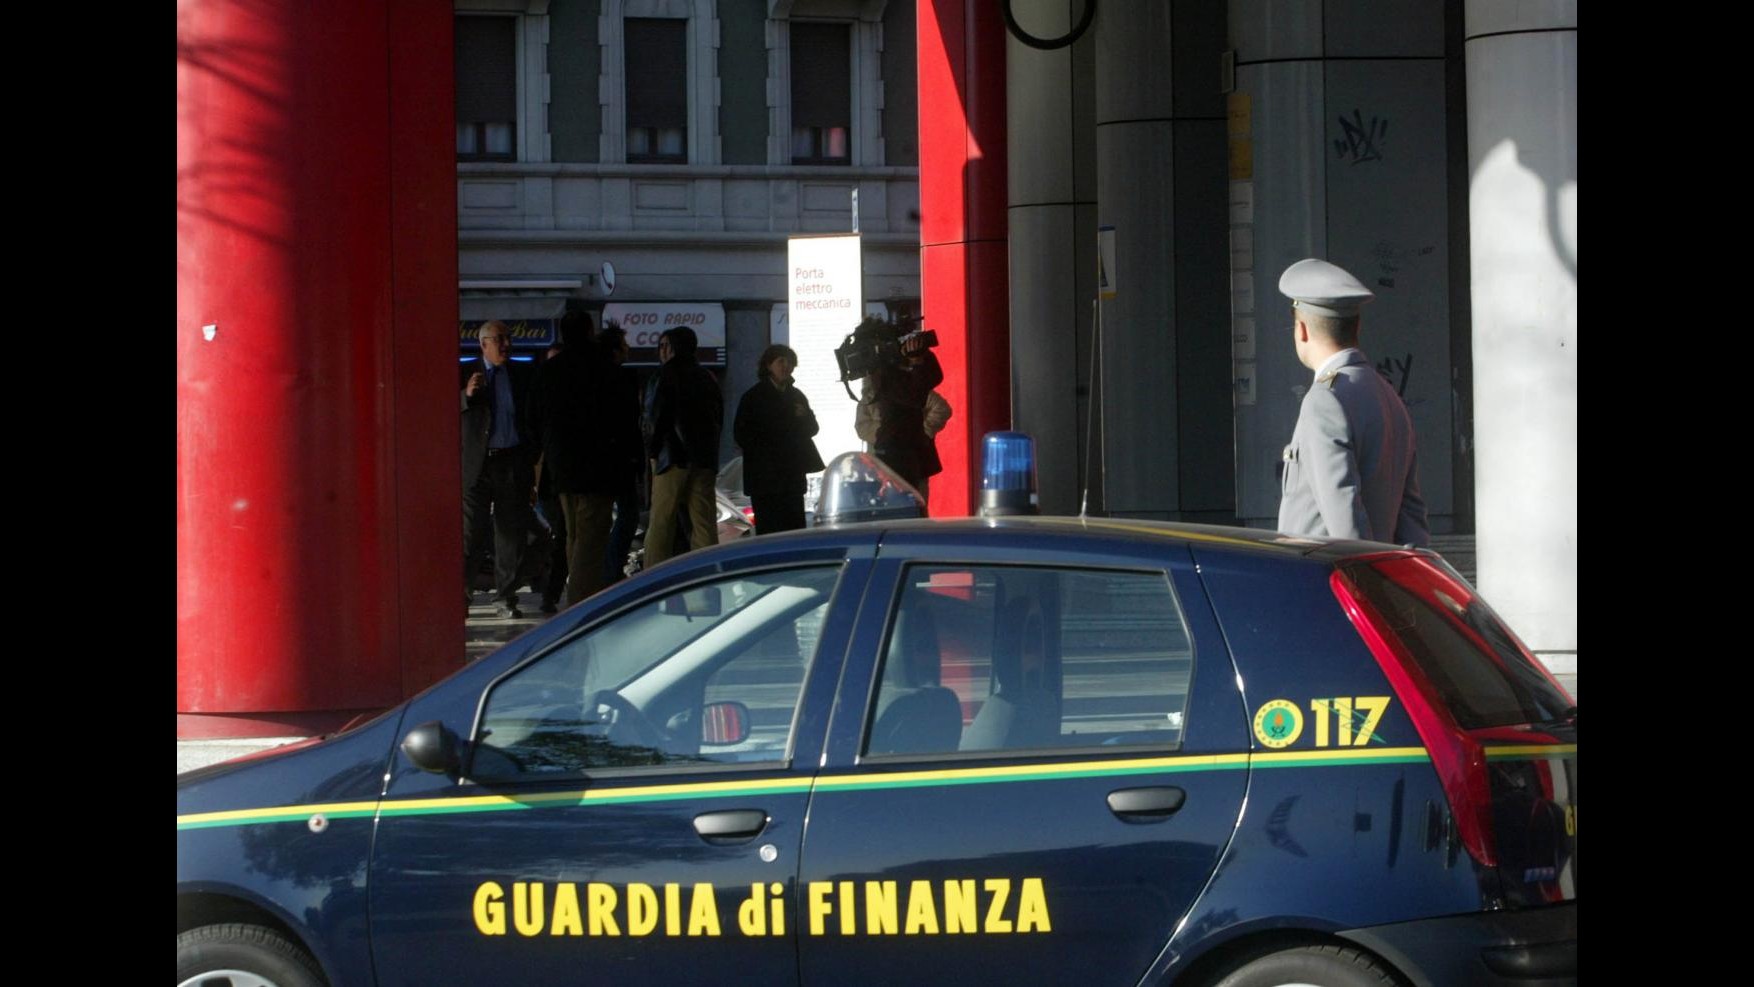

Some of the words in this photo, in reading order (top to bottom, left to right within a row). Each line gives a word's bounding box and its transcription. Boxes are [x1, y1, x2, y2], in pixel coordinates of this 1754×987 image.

[795, 268, 825, 279] Porta
[795, 282, 832, 295] elettro
[795, 298, 851, 310] meccanica
[623, 312, 658, 325] FOTO
[664, 312, 706, 325] RAPID
[511, 321, 547, 338] Bar
[1311, 696, 1391, 747] 117
[472, 880, 721, 937] GUARDIA
[738, 882, 785, 936] di
[809, 877, 1053, 936] FINANZA
